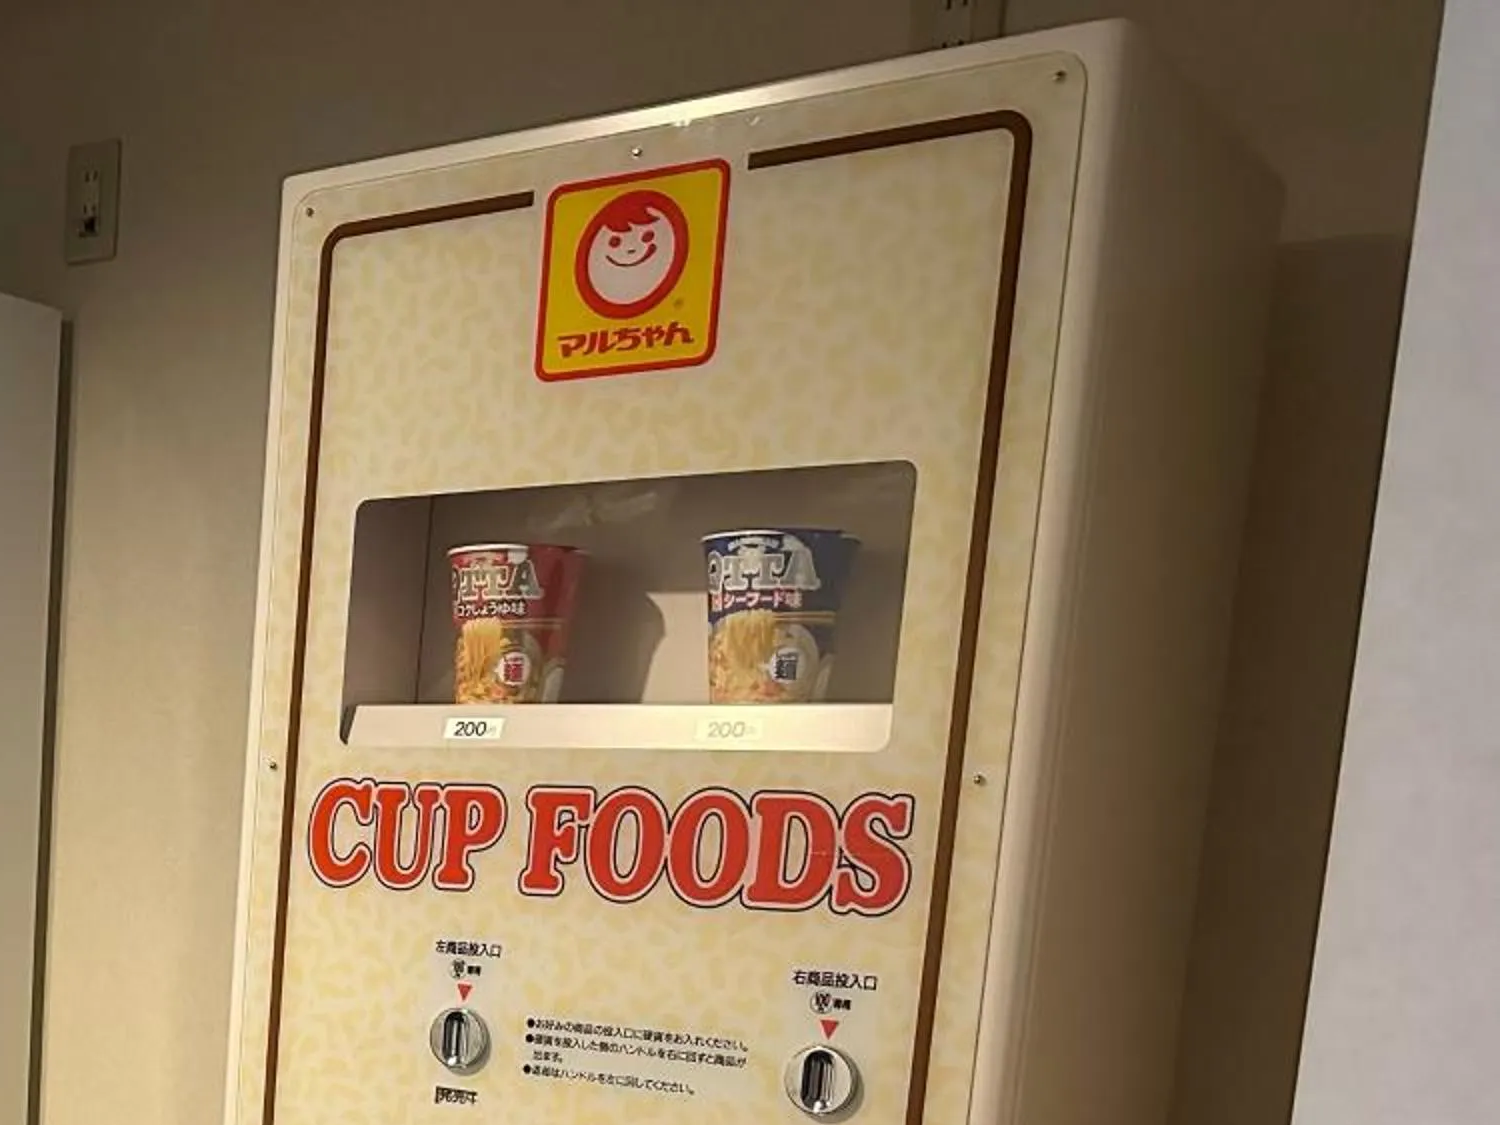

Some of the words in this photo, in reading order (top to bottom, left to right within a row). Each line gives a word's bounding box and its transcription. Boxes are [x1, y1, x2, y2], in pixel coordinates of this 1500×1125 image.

[557, 321, 695, 358] マルちゃん
[308, 778, 506, 890] CUP
[518, 786, 916, 916] FOODS
[435, 939, 503, 958] 左商品投入口
[792, 970, 878, 991] 右商品投入口
